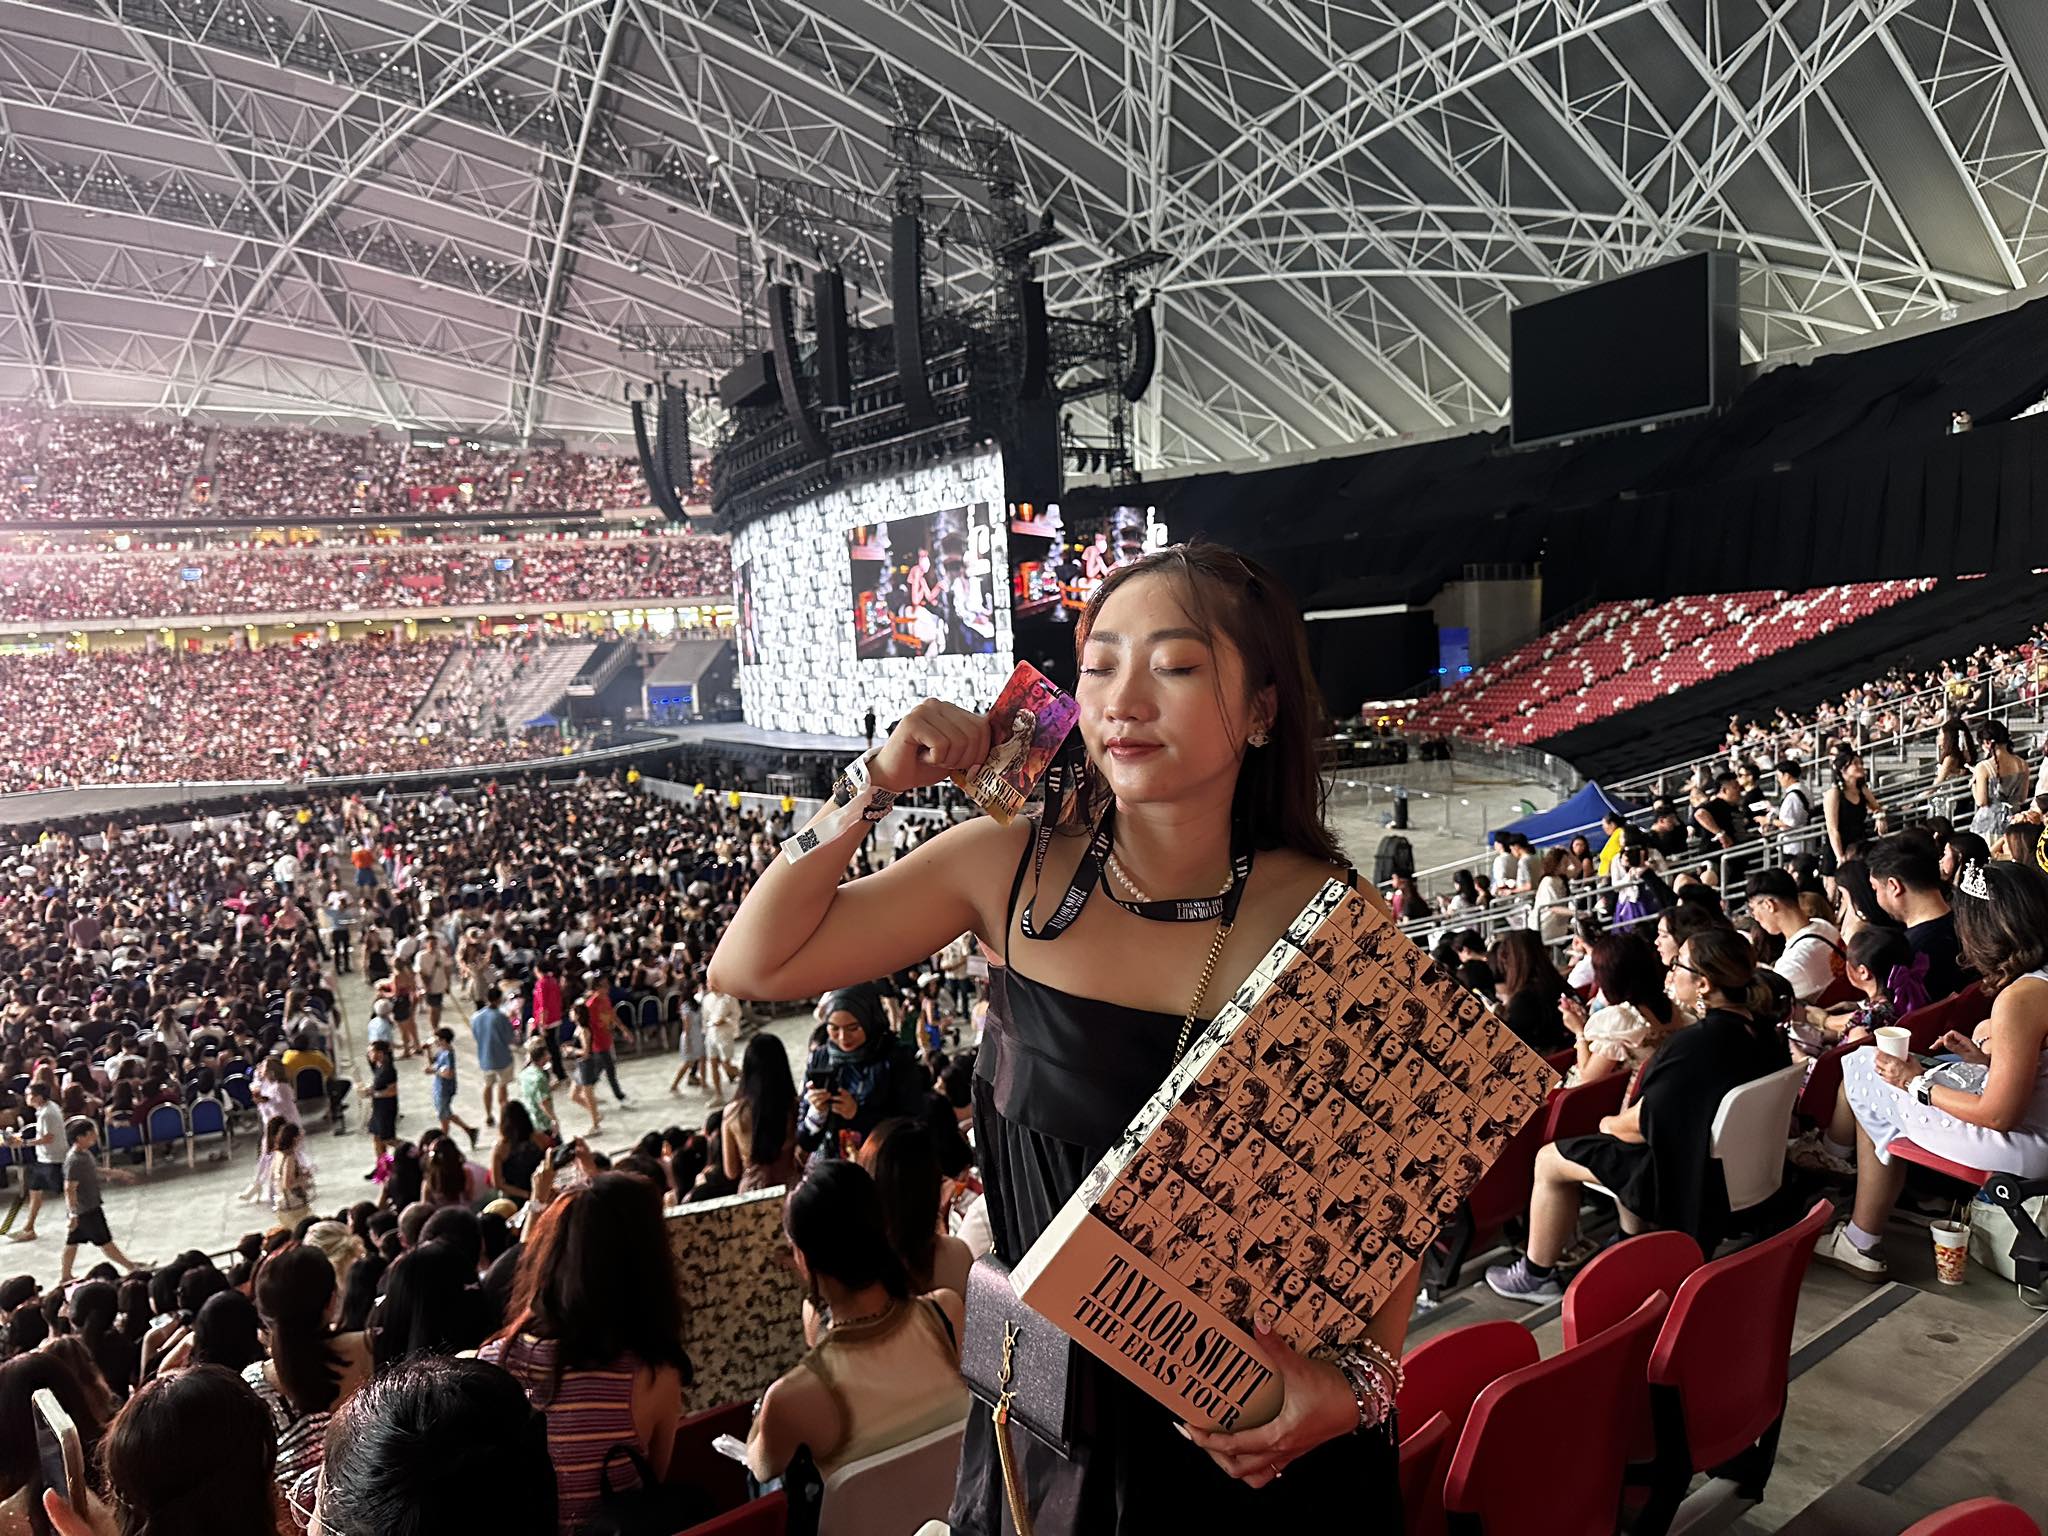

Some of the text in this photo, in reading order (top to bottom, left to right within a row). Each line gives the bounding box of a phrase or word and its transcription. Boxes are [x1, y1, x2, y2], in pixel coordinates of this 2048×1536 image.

[993, 778, 1022, 808] SWIFT
[1048, 766, 1063, 793] VIP
[993, 795, 1014, 816] TOUR
[1048, 885, 1082, 928] TAYLOR SWIFT
[1177, 904, 1224, 920] TAYLOR SWIFT
[1995, 1185, 2009, 1200] Q
[1089, 1253, 1198, 1355] TAYLOR
[1182, 1326, 1273, 1408] SWIFT
[1073, 1296, 1241, 1430] THE ERAS TOUR
